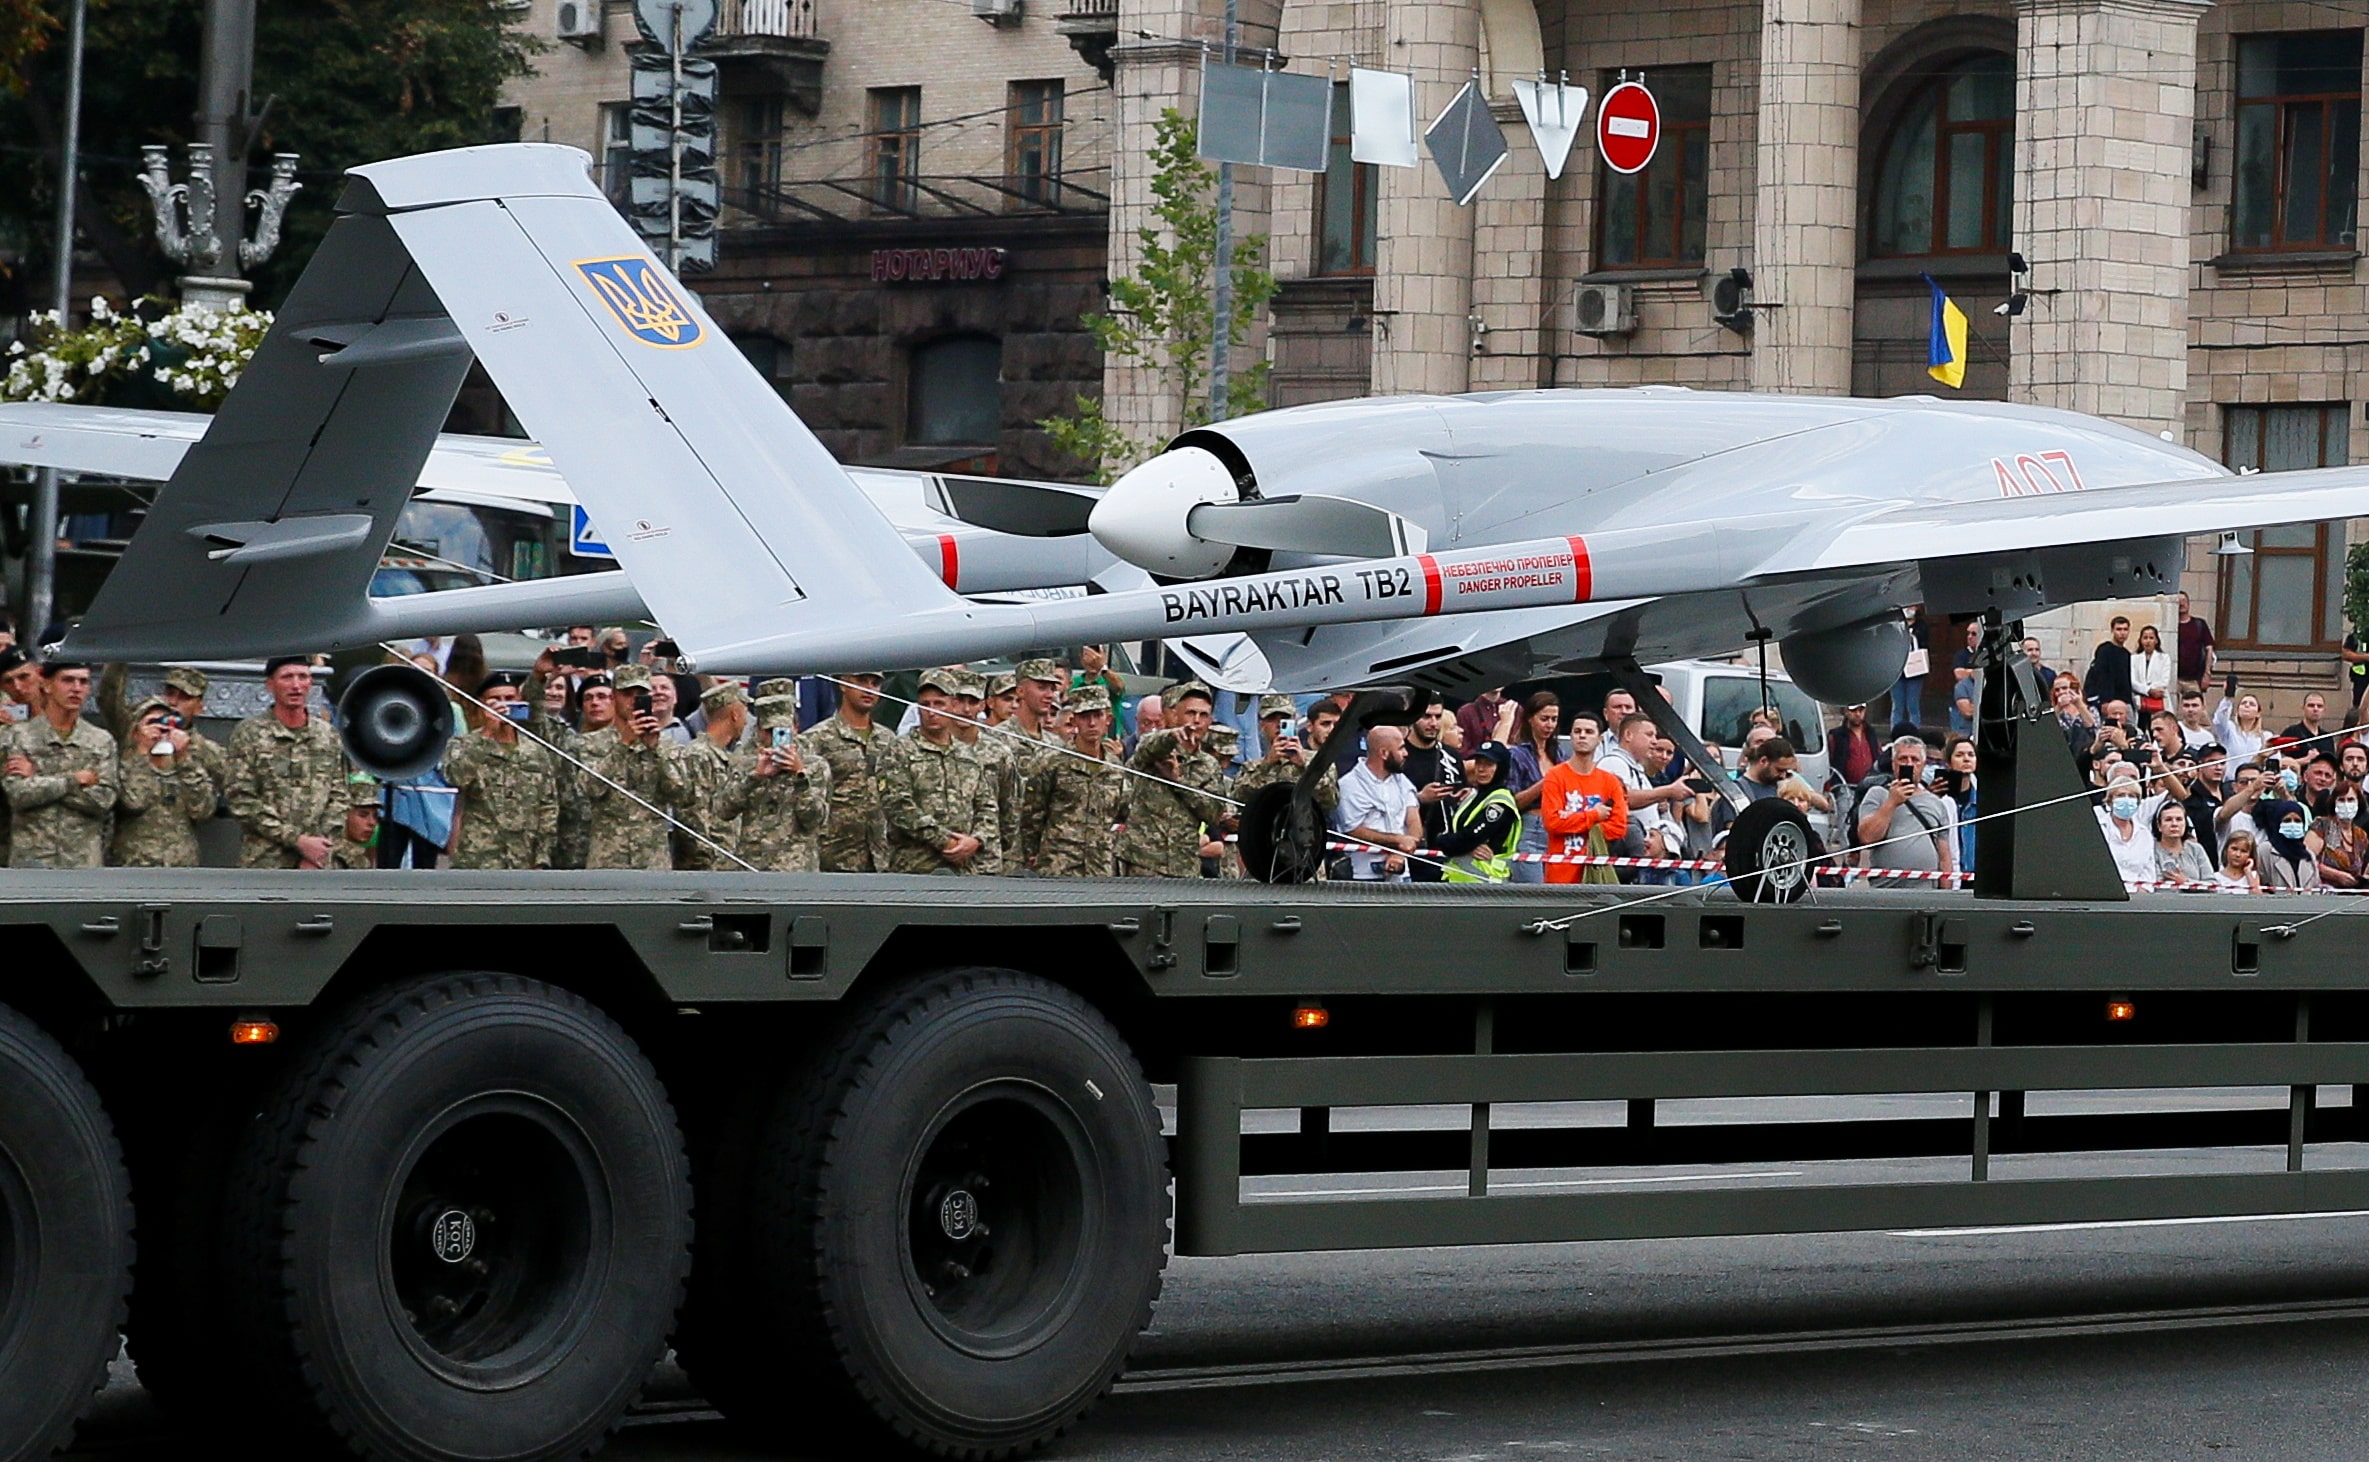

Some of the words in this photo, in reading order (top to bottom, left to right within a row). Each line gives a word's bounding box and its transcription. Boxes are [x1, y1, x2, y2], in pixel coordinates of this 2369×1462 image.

[872, 247, 1004, 281] НОТАРИУС
[1442, 559, 1515, 578] НЕБЕЗПЕЧНО
[1517, 554, 1573, 570] ПРОПЕЛЕР
[1161, 575, 1345, 622] BAYRAKTAR
[1356, 568, 1413, 599] TB2
[1458, 578, 1502, 594] DANGER
[1504, 572, 1563, 589] PROPELLER
